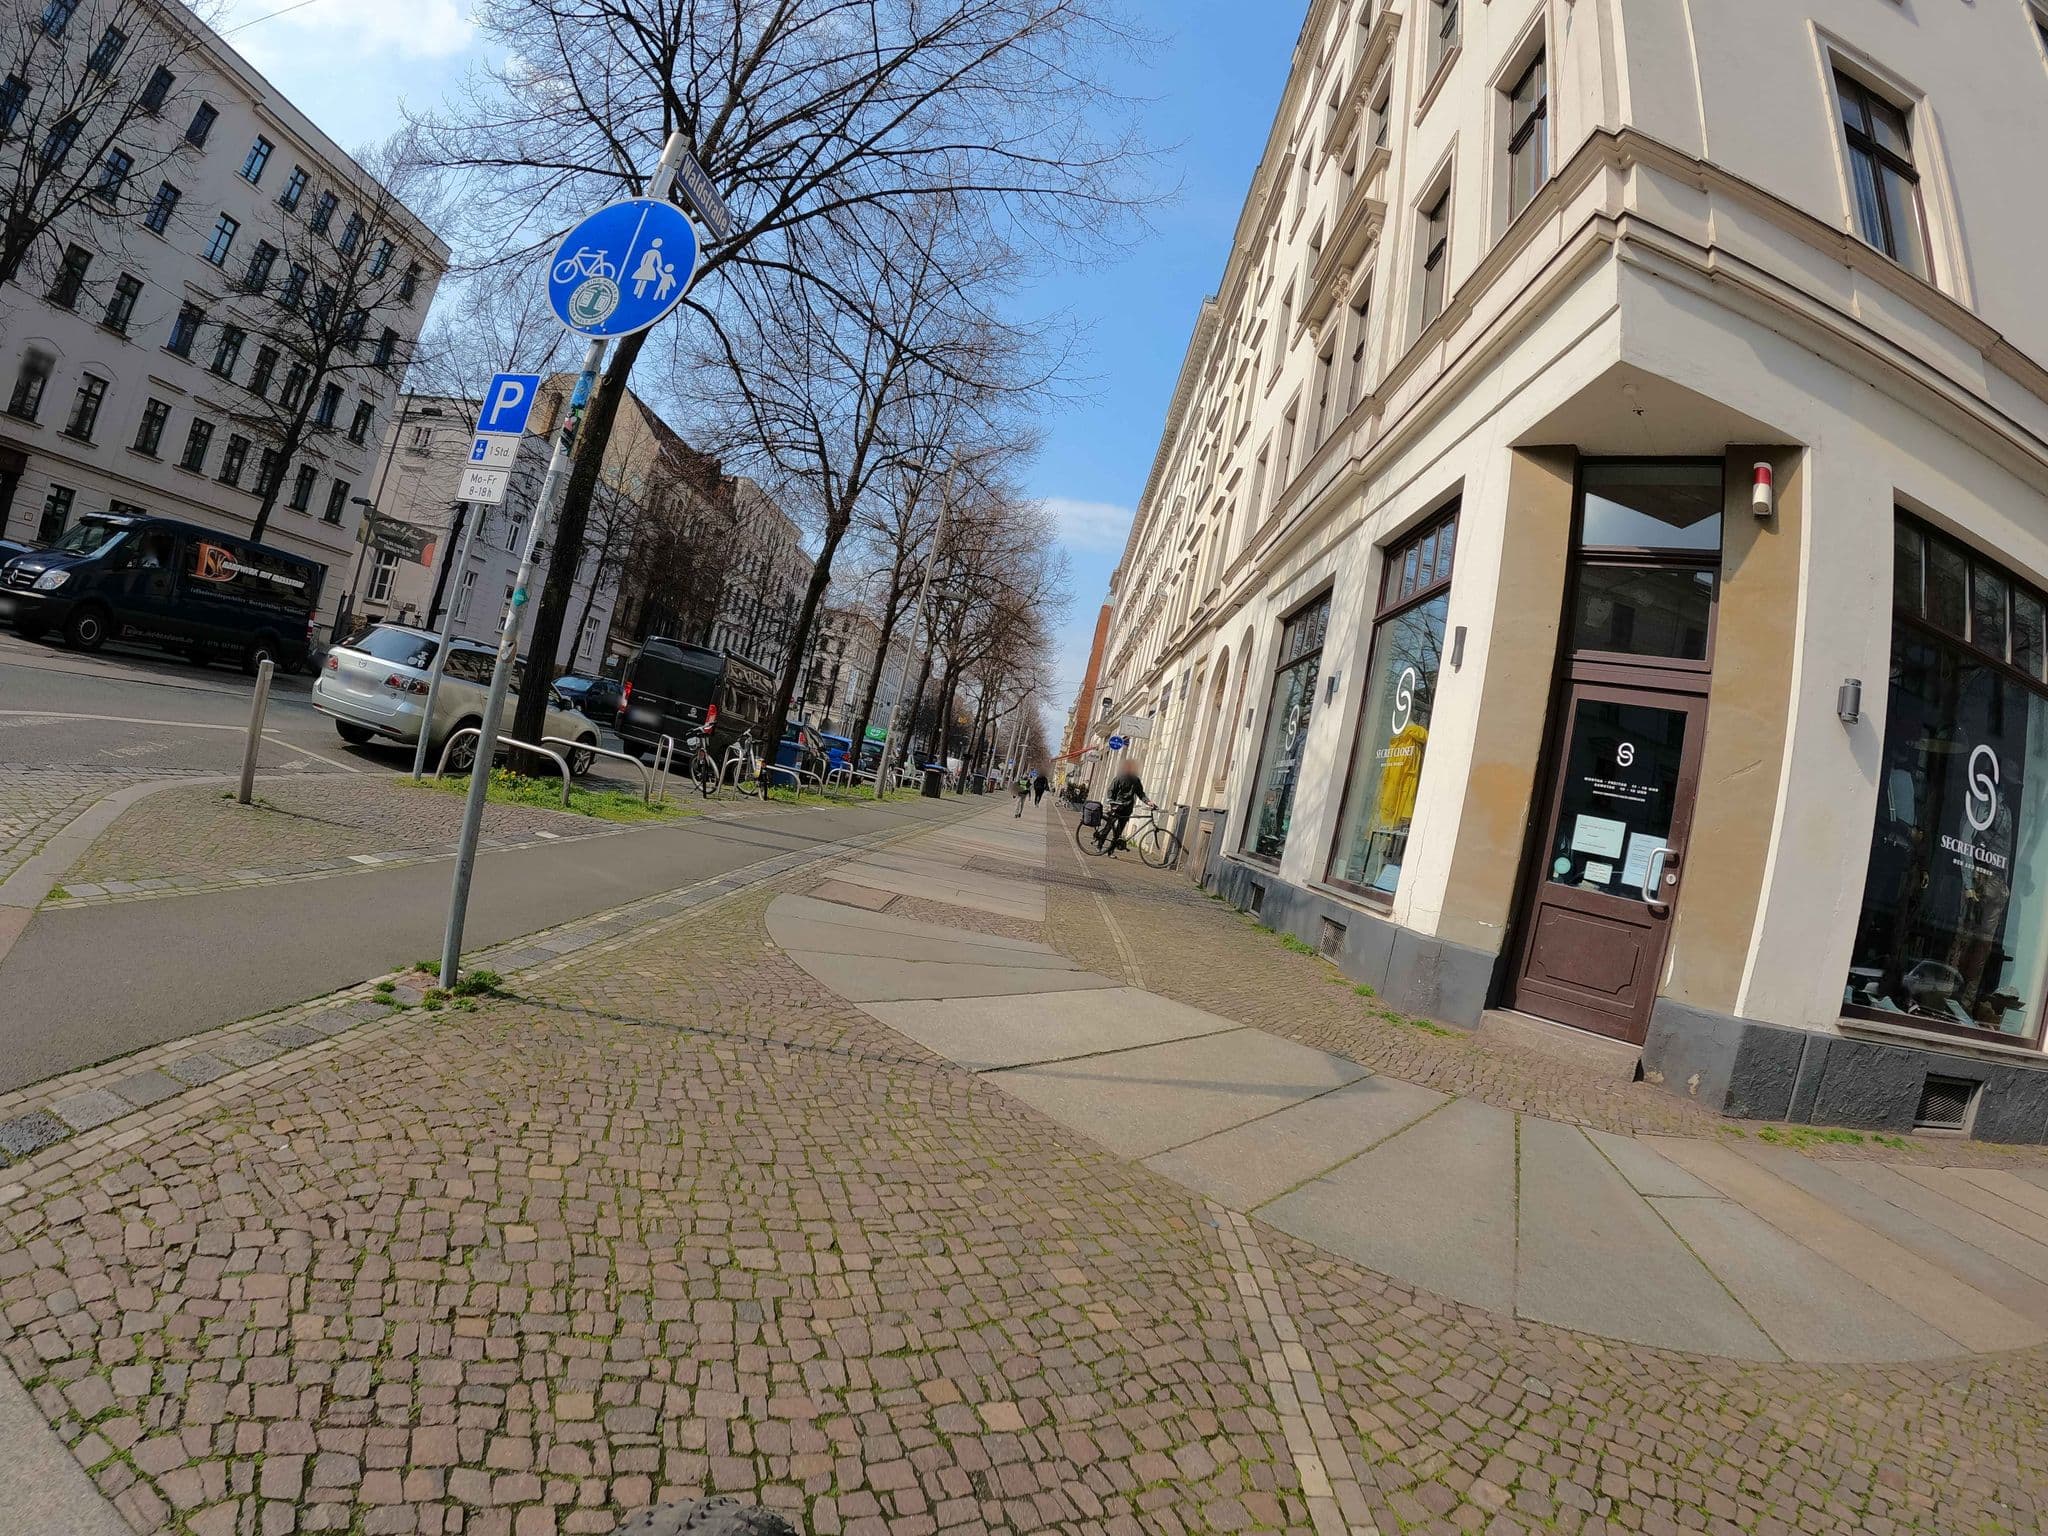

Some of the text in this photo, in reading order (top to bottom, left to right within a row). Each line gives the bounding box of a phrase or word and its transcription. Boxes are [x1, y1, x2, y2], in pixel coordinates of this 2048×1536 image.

[681, 155, 729, 233] Waldstraße
[489, 381, 524, 425] P
[470, 473, 498, 486] Mo-Fr
[1940, 834, 2008, 870] SECRET CLOSET
